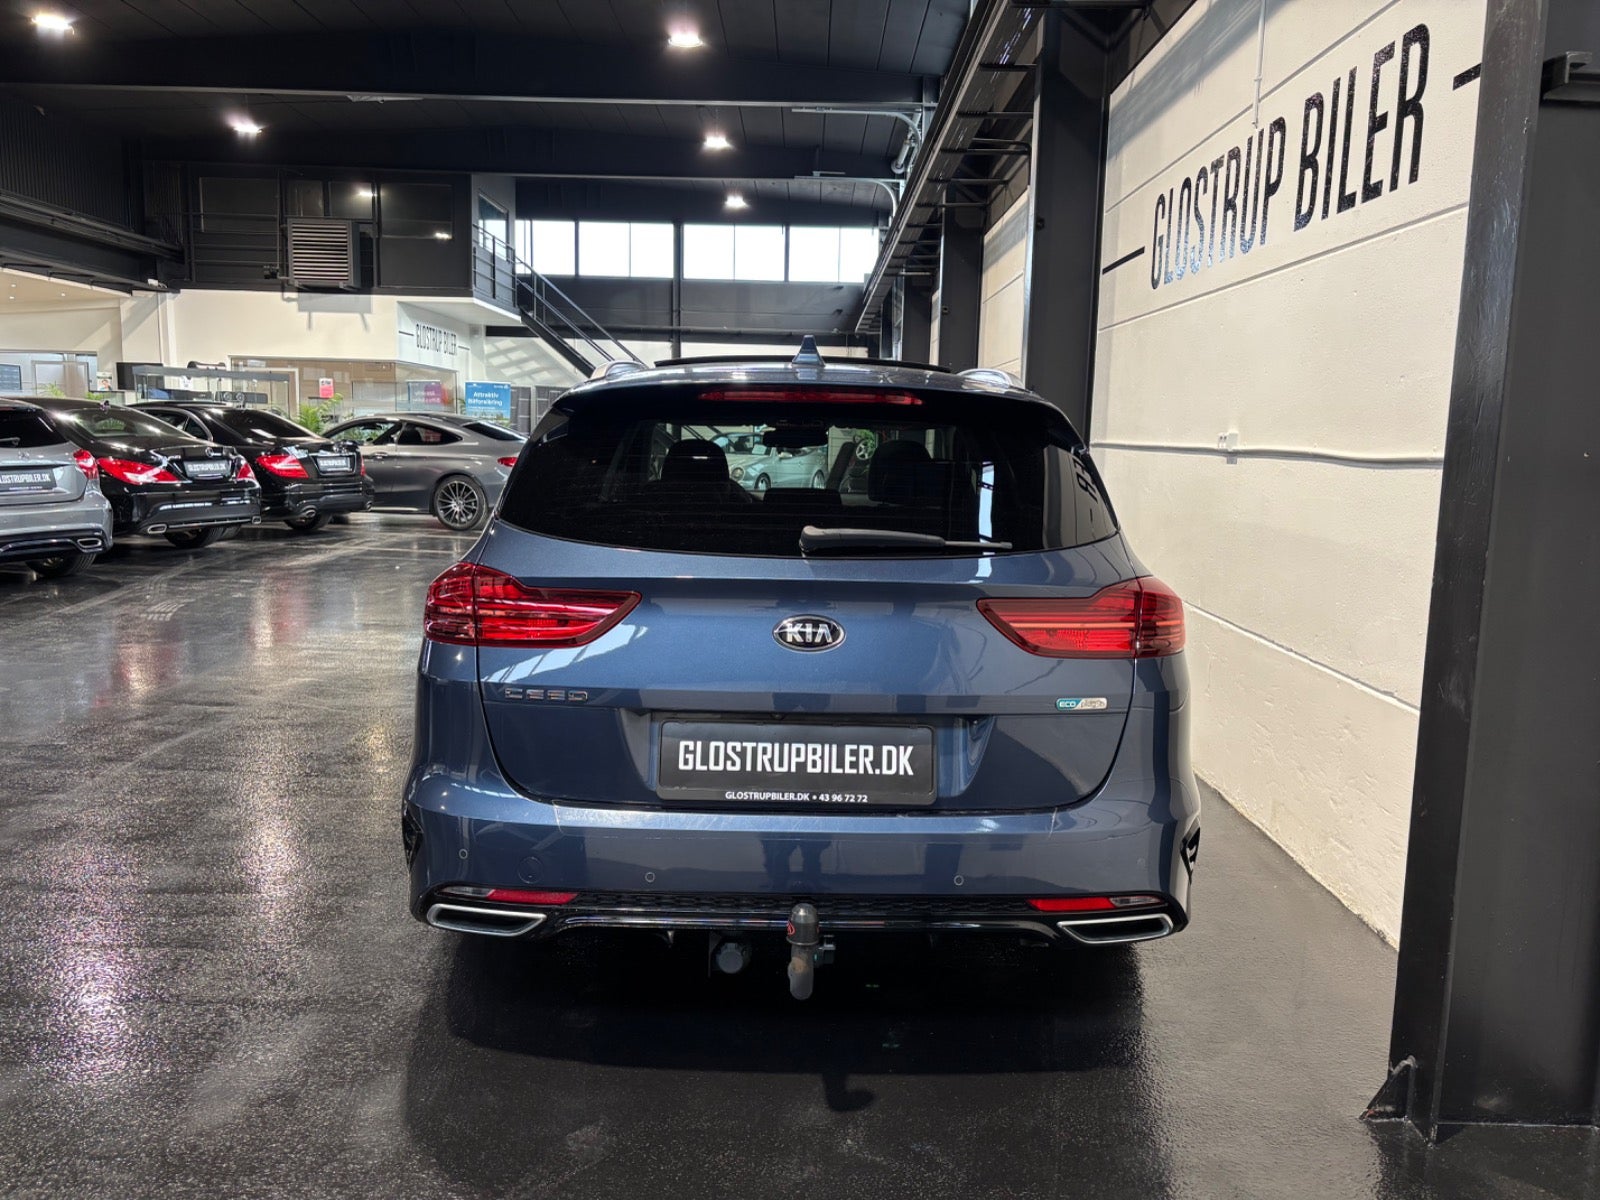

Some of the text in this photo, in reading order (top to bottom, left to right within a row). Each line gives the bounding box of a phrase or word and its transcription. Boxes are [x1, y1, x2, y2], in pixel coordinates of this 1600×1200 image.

[1150, 23, 1430, 290] GLOSTRUP BILER
[785, 623, 833, 643] KIA
[505, 687, 588, 701] CEED
[678, 740, 914, 776] GLOSTRUPBILER.DK
[725, 791, 868, 803] GLOSTRUPBILER.DK 43 96 72 72
